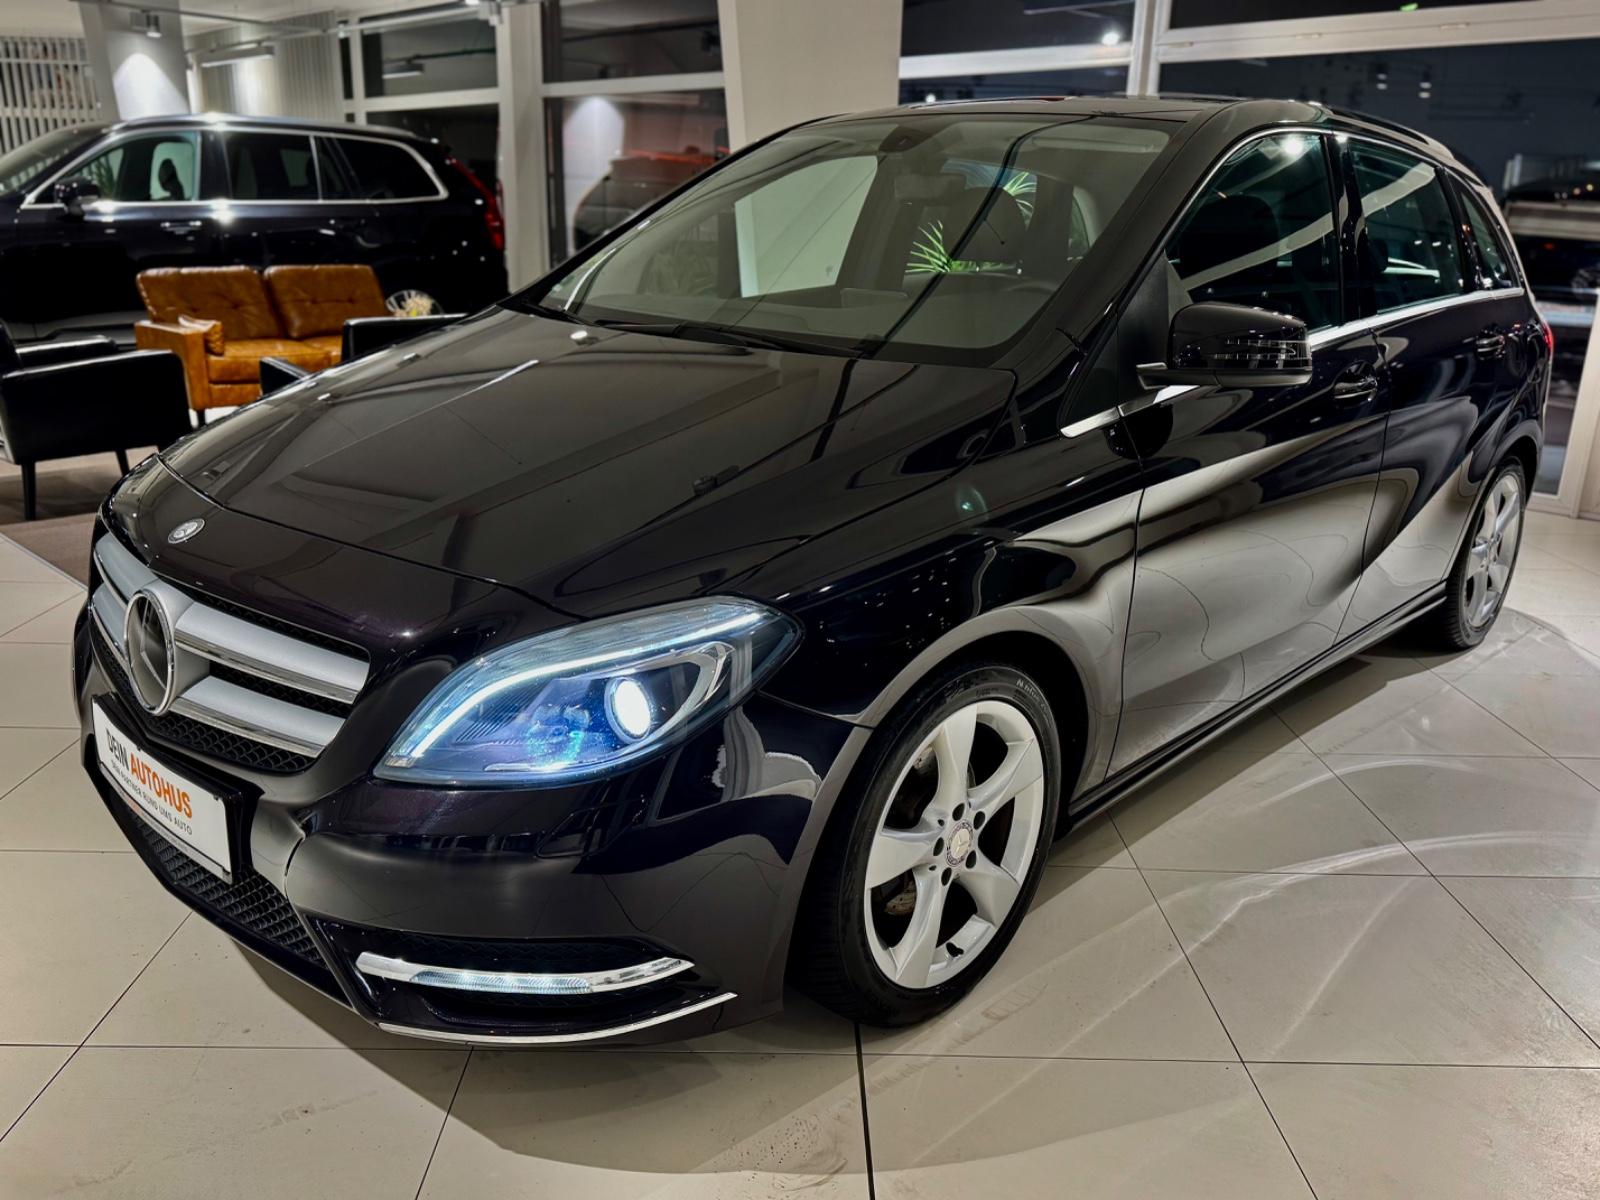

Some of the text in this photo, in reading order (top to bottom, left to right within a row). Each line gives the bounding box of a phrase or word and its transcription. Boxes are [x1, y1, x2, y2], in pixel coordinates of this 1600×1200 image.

[106, 728, 129, 771] DEIN
[130, 752, 192, 819] AUTOHUS
[174, 817, 192, 835] AUTO
